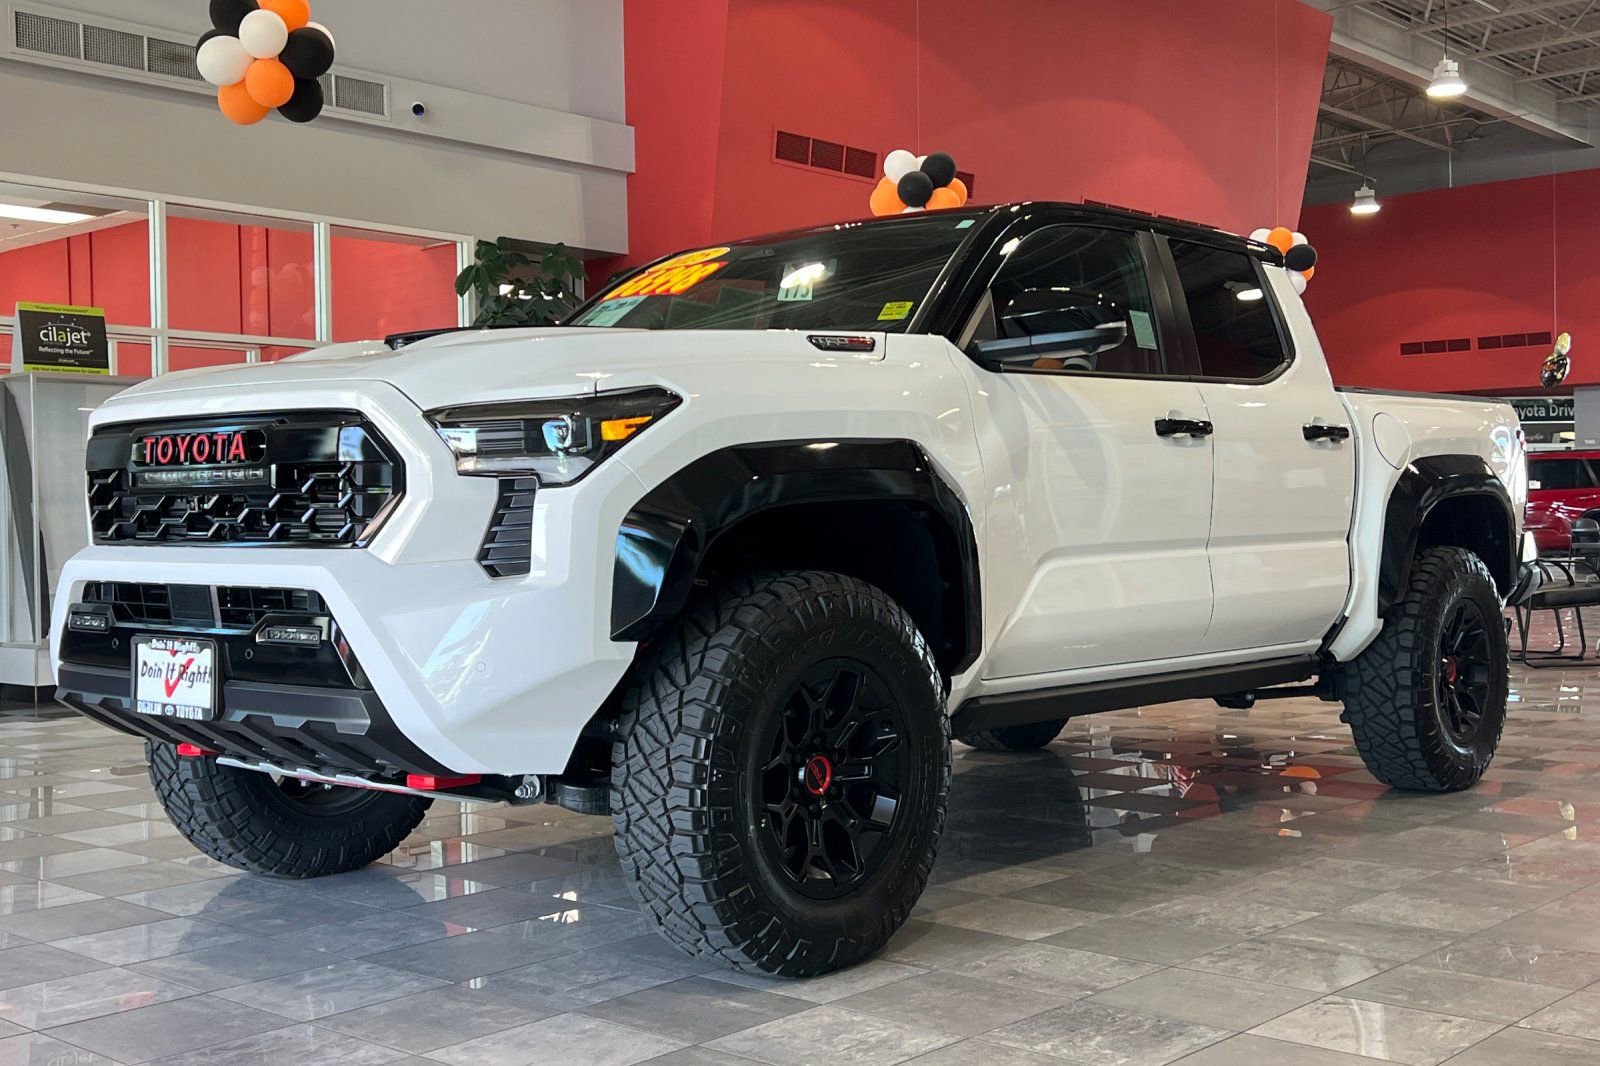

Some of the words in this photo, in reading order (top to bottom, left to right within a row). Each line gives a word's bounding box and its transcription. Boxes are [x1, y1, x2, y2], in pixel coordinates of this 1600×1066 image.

[40, 326, 88, 346] cilajet
[38, 346, 65, 355] Reflecting
[1549, 403, 1574, 416] Driv
[143, 432, 246, 464] TOYOTA
[166, 662, 176, 681] It
[177, 664, 212, 689] Right!
[176, 705, 203, 720] TOYOTA
